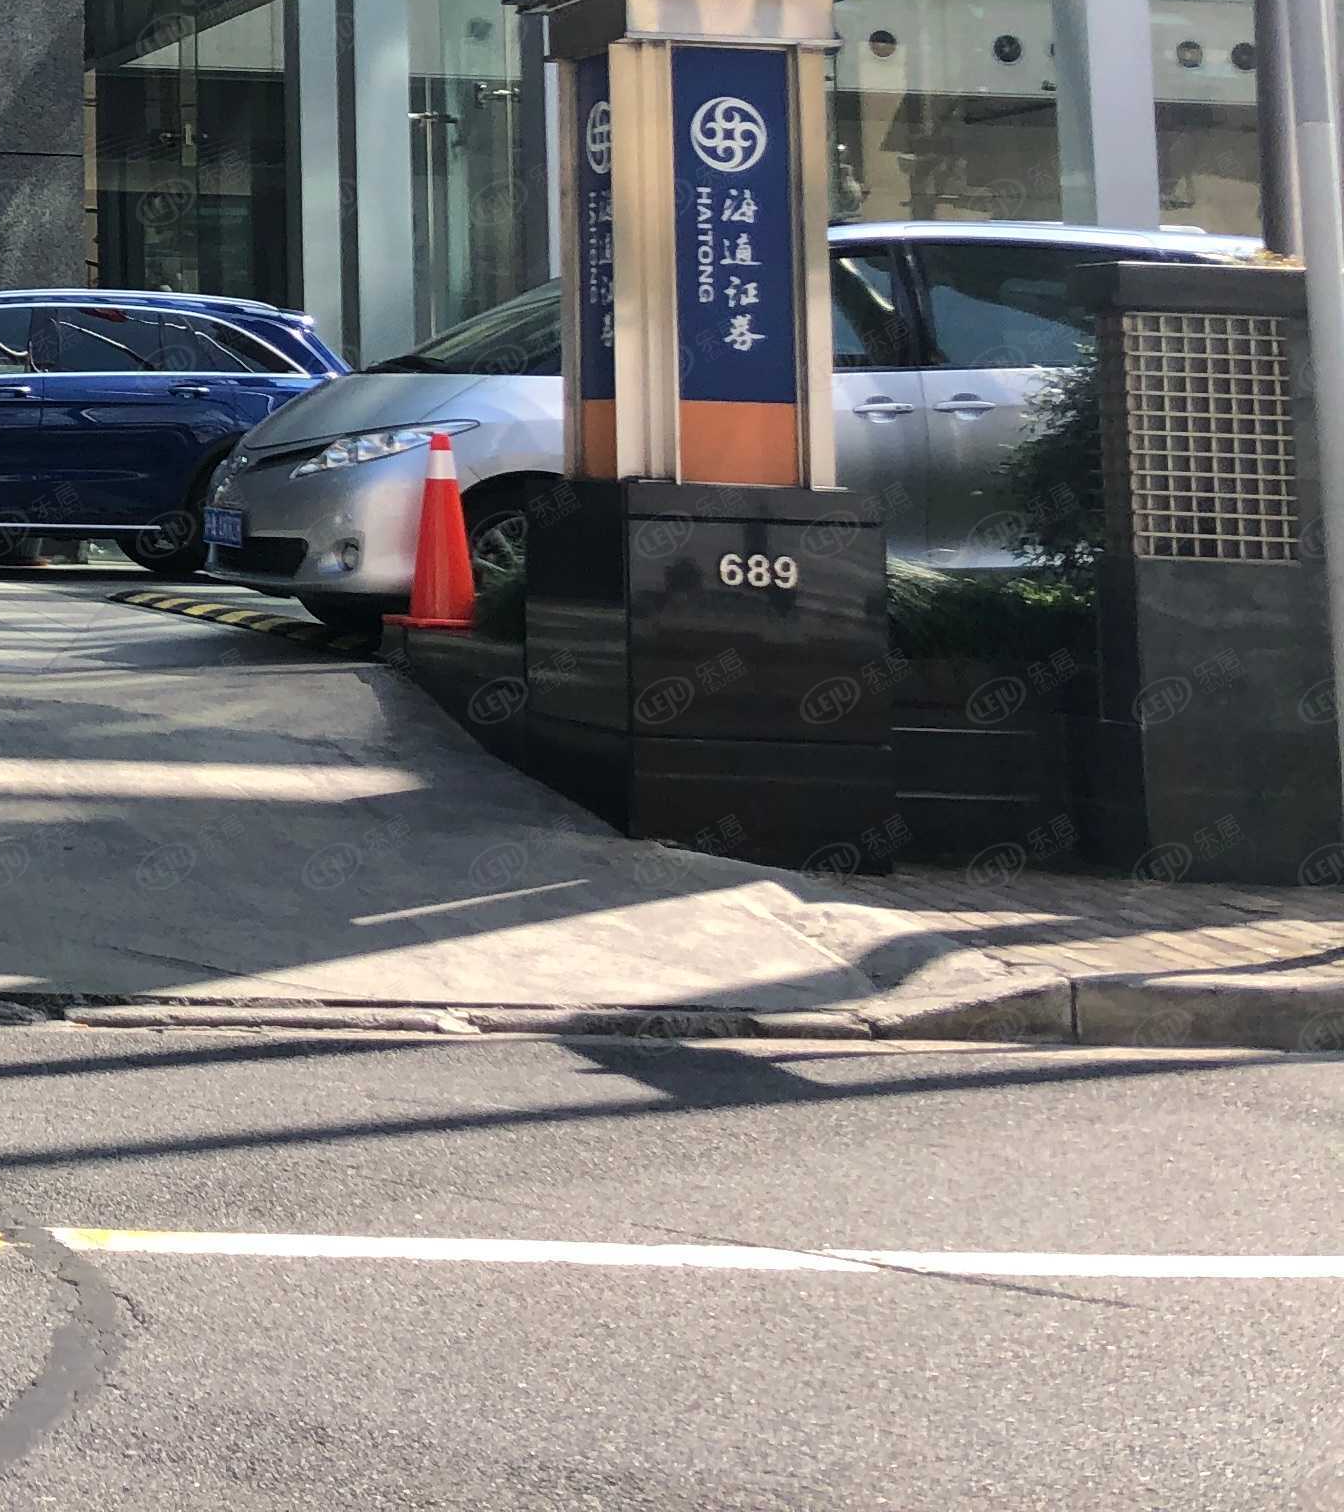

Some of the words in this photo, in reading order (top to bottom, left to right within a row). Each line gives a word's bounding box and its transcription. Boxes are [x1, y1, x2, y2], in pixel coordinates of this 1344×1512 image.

[696, 187, 714, 303] HAITONG
[719, 189, 766, 351] 海通证券
[719, 553, 799, 589] 689
